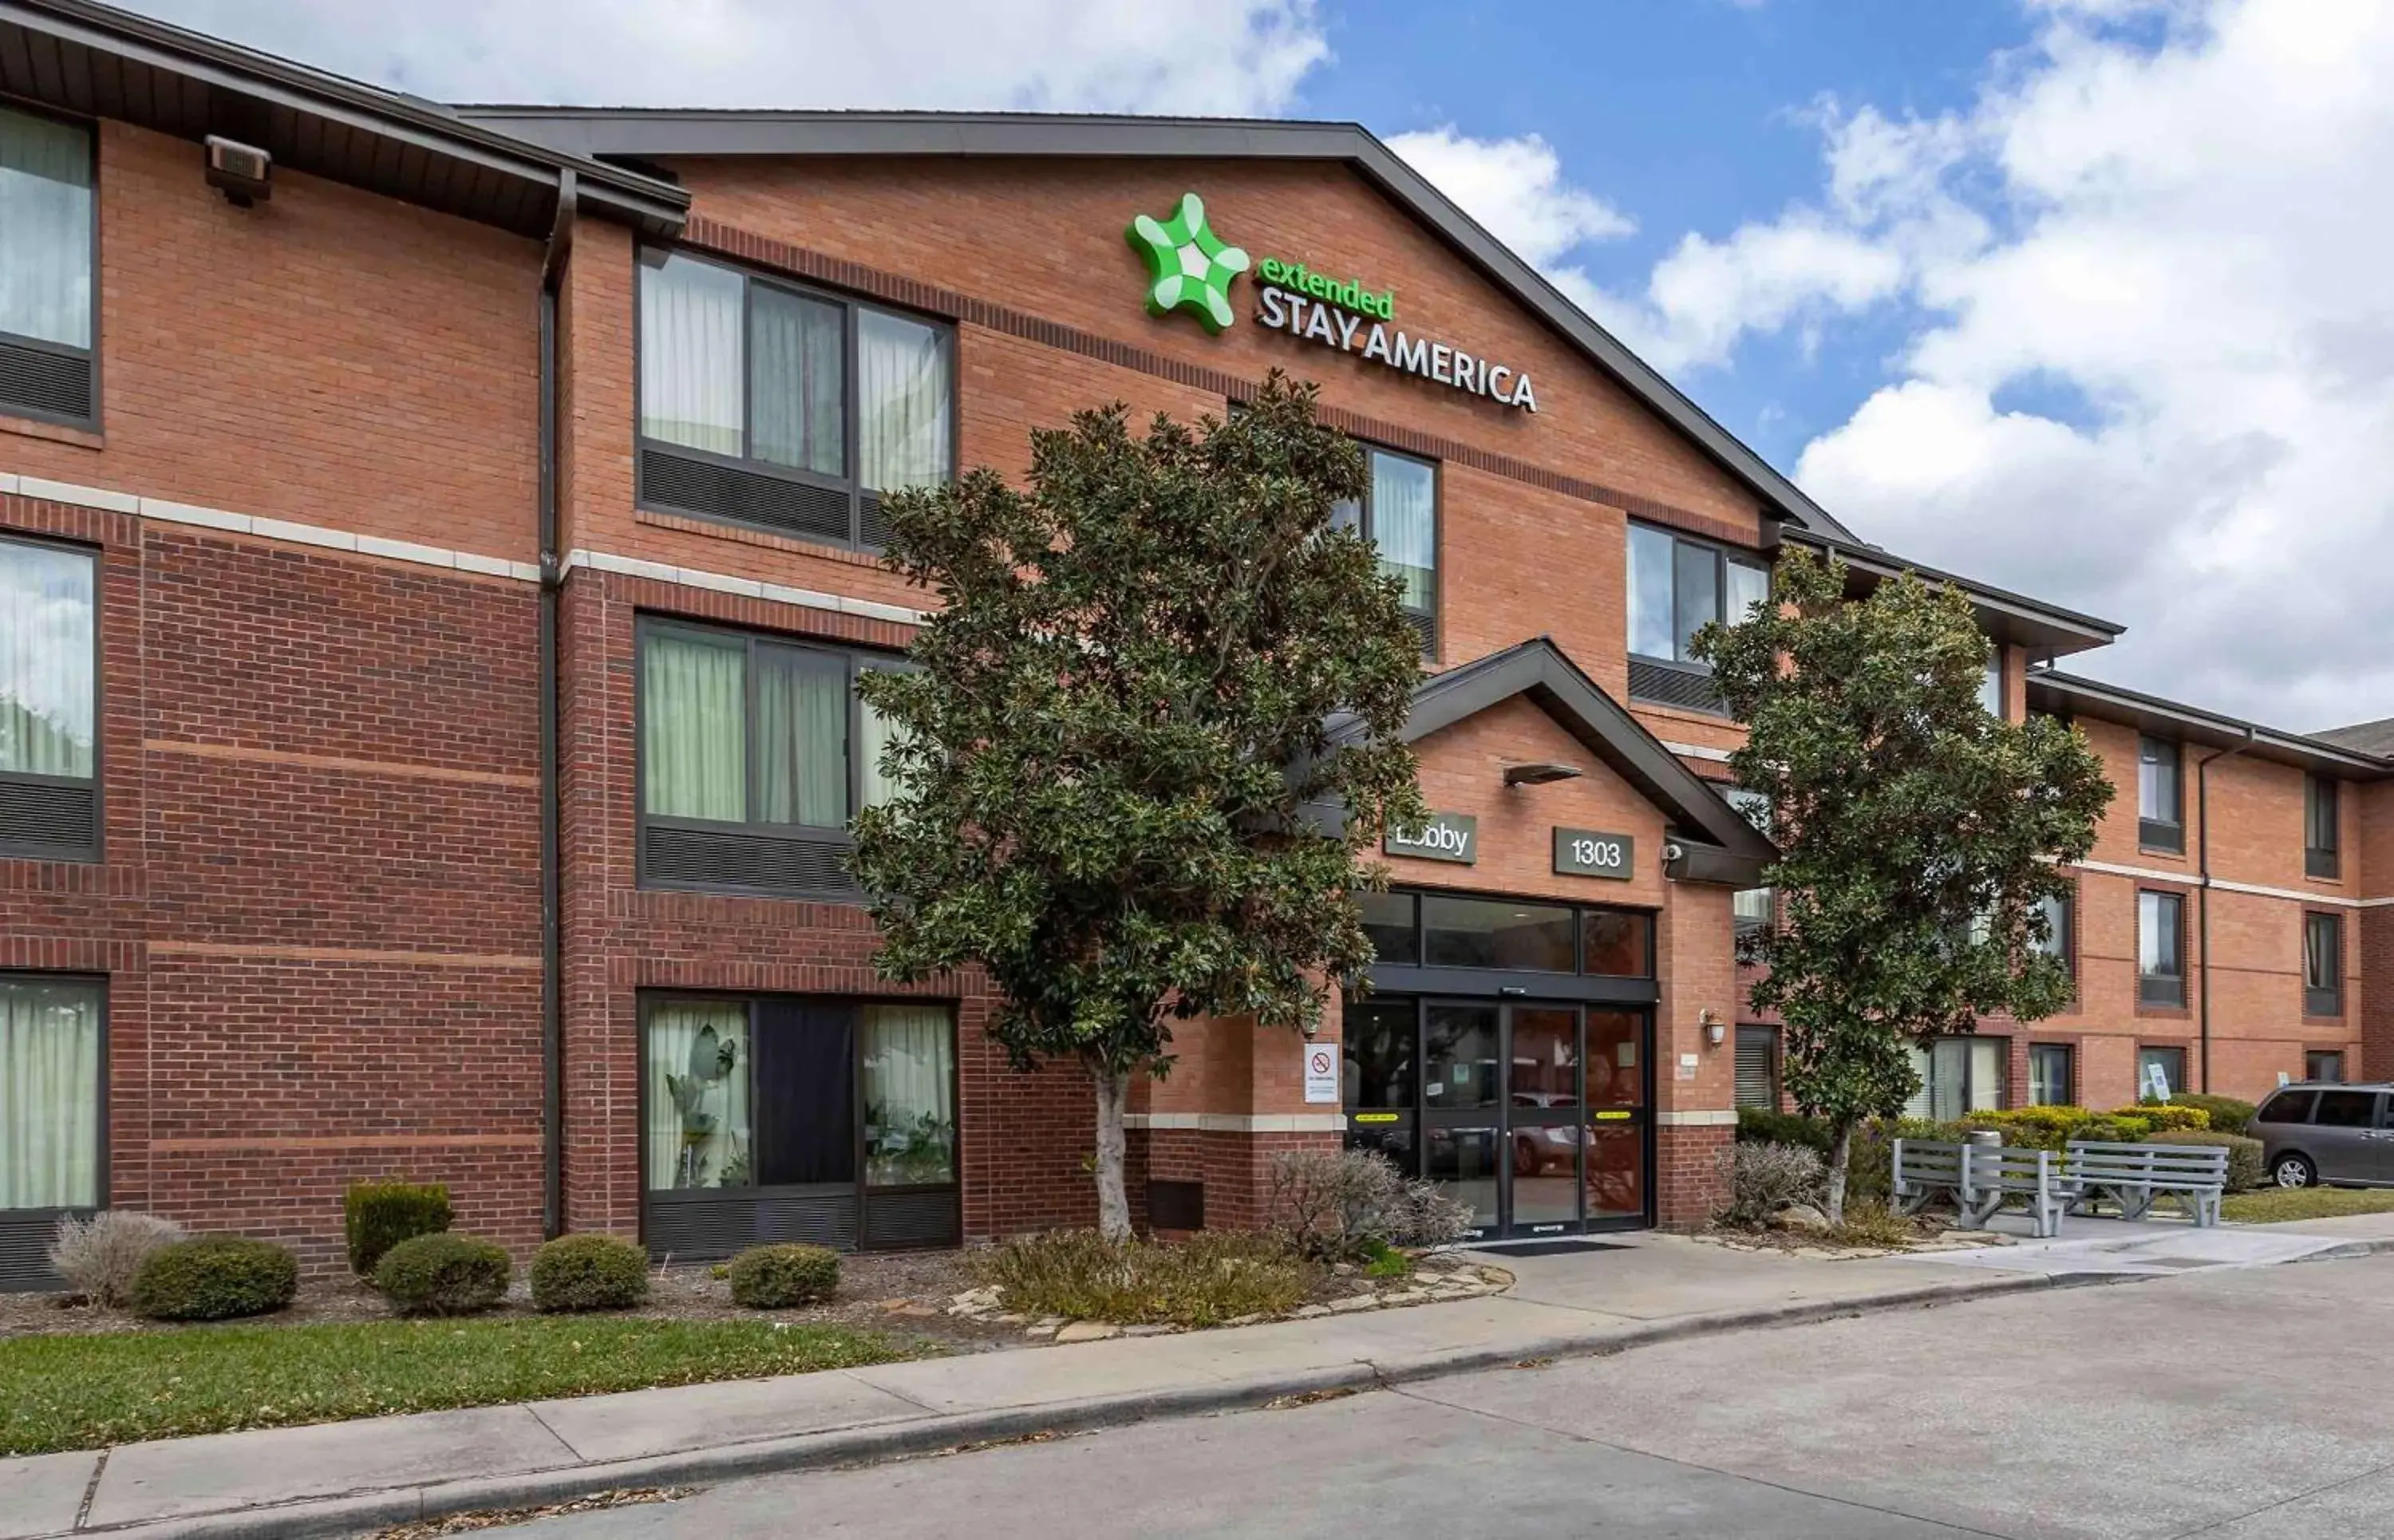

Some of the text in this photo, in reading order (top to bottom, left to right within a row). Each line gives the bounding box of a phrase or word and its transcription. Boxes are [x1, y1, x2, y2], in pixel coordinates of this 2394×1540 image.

[1260, 258, 1395, 321] extended
[1262, 286, 1536, 413] STAY AMERICA
[1571, 839, 1621, 867] 1303
